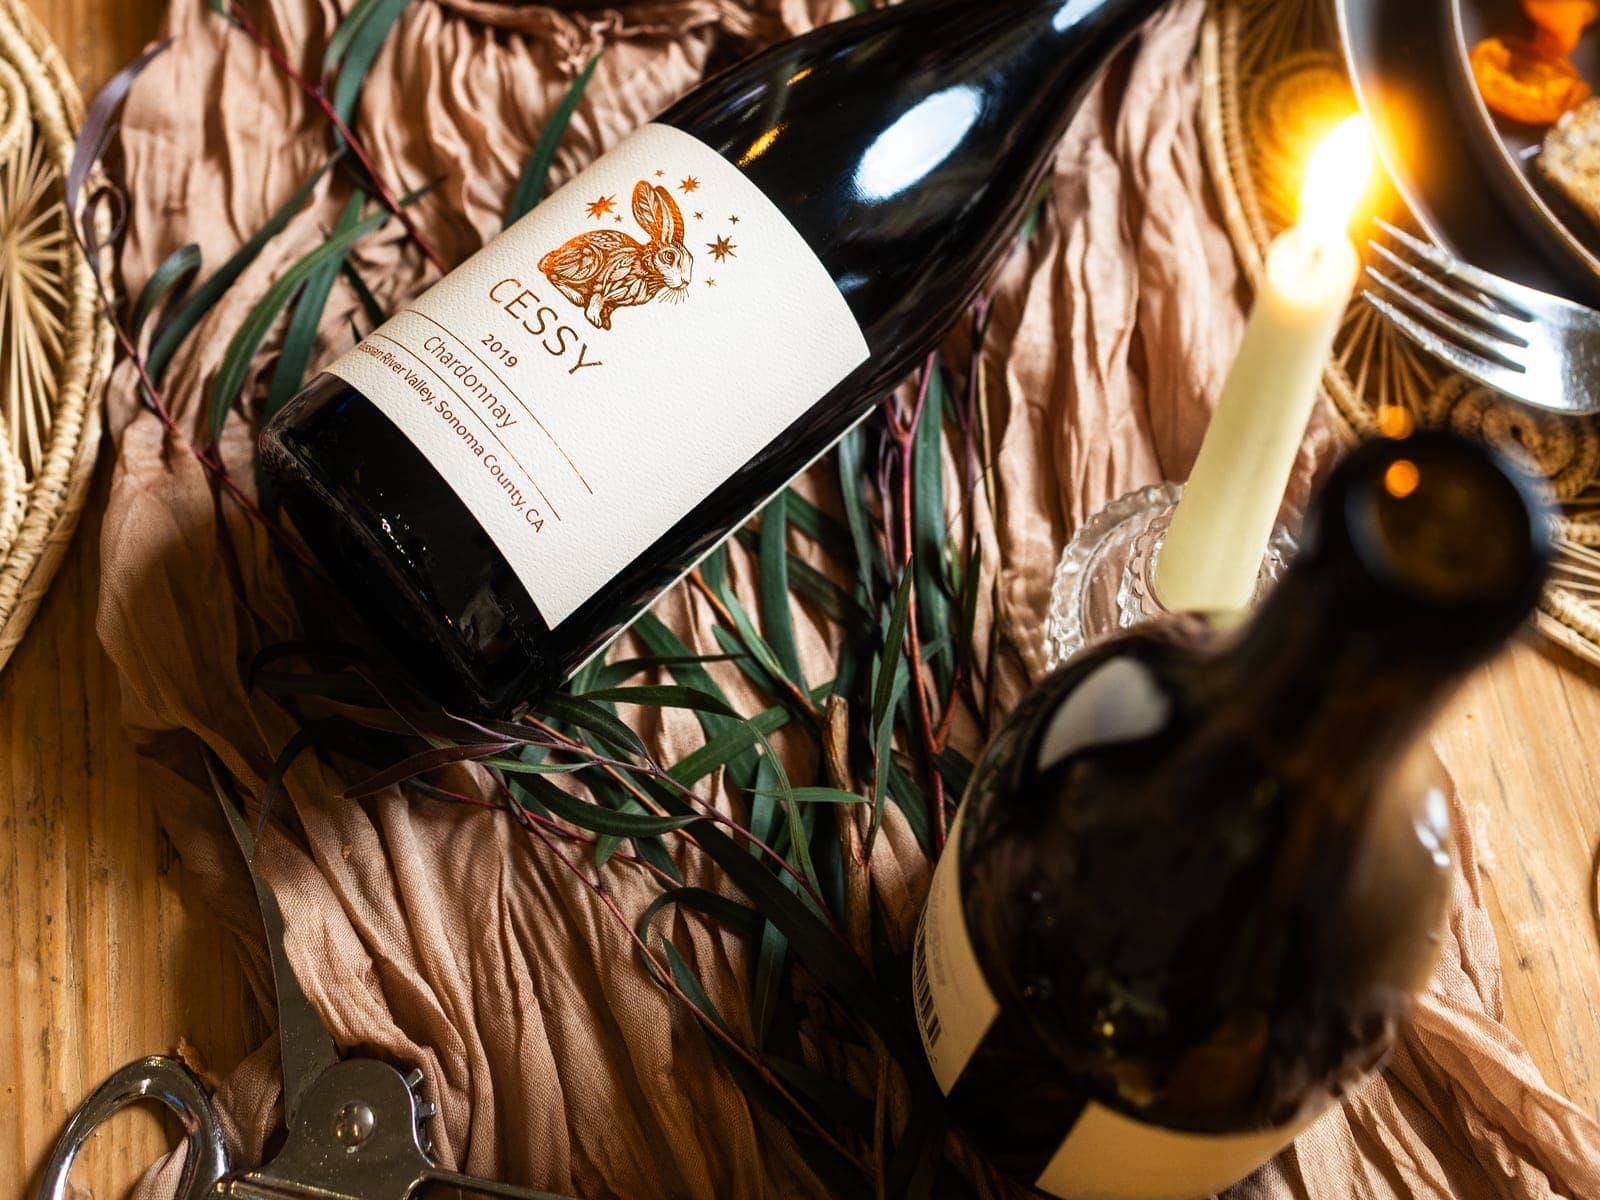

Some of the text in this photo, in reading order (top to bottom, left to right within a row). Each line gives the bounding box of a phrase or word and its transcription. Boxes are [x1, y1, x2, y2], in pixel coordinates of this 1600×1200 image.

[481, 334, 520, 368] 2019
[488, 278, 603, 376] CESSY
[423, 335, 518, 430] Chardonnay
[381, 352, 406, 375] River
[403, 369, 436, 405] Valley,
[434, 400, 484, 457] Sonoma
[483, 454, 527, 511] County,
[526, 508, 545, 533] CA
